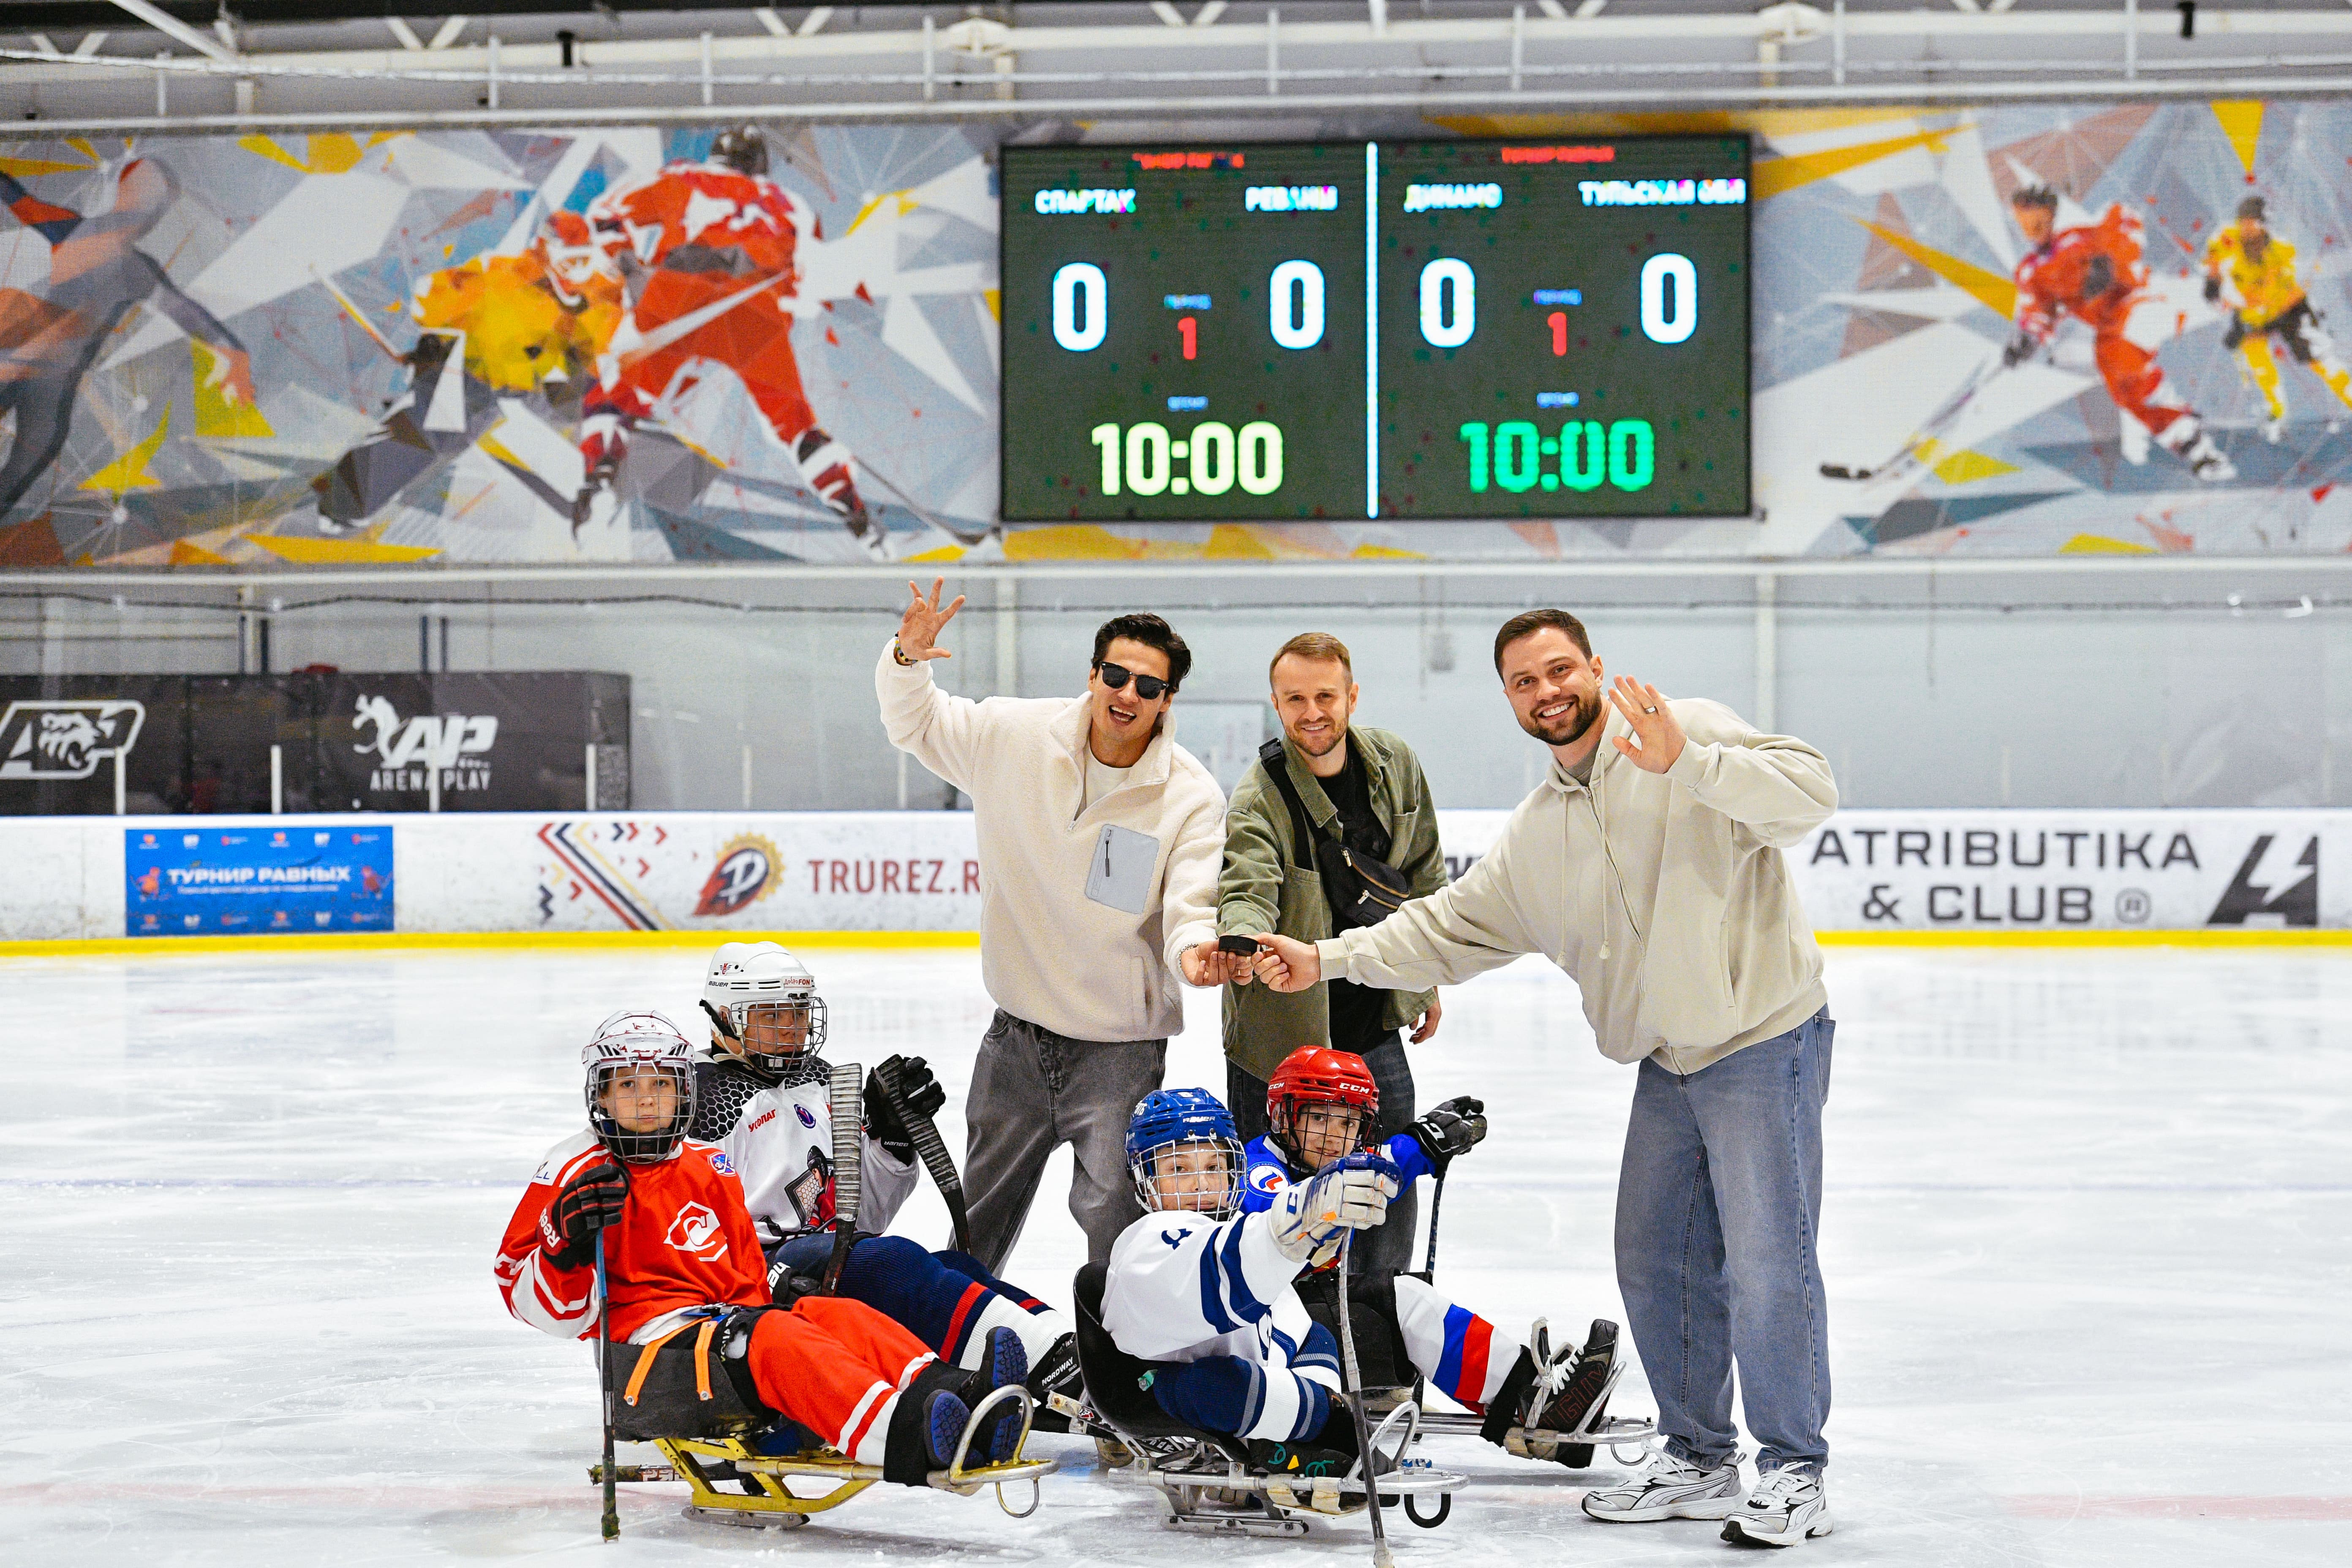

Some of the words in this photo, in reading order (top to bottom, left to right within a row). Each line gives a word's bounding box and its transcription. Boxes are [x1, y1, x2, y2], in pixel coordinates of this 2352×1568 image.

[1035, 188, 1136, 213] СПАРТАК
[1053, 262, 1107, 351] 0
[1270, 260, 1325, 349] 0
[1420, 257, 1475, 347] 0
[1640, 253, 1697, 344] 0
[1178, 316, 1197, 359] 1
[1548, 312, 1567, 356] 1
[1092, 421, 1283, 495] 10:00
[1460, 419, 1655, 493] 10:00
[444, 770, 490, 791] PLAY
[1811, 829, 2200, 871] ATRIBUTIKA
[166, 868, 254, 885] ТУРНИР
[258, 866, 351, 883] РАВНЫХ
[1862, 884, 1901, 923] &
[1927, 885, 2094, 924] CLUB
[1268, 1082, 1285, 1090] CCM
[1339, 1083, 1370, 1094] CCM
[1042, 1356, 1073, 1386] NORDWAY
